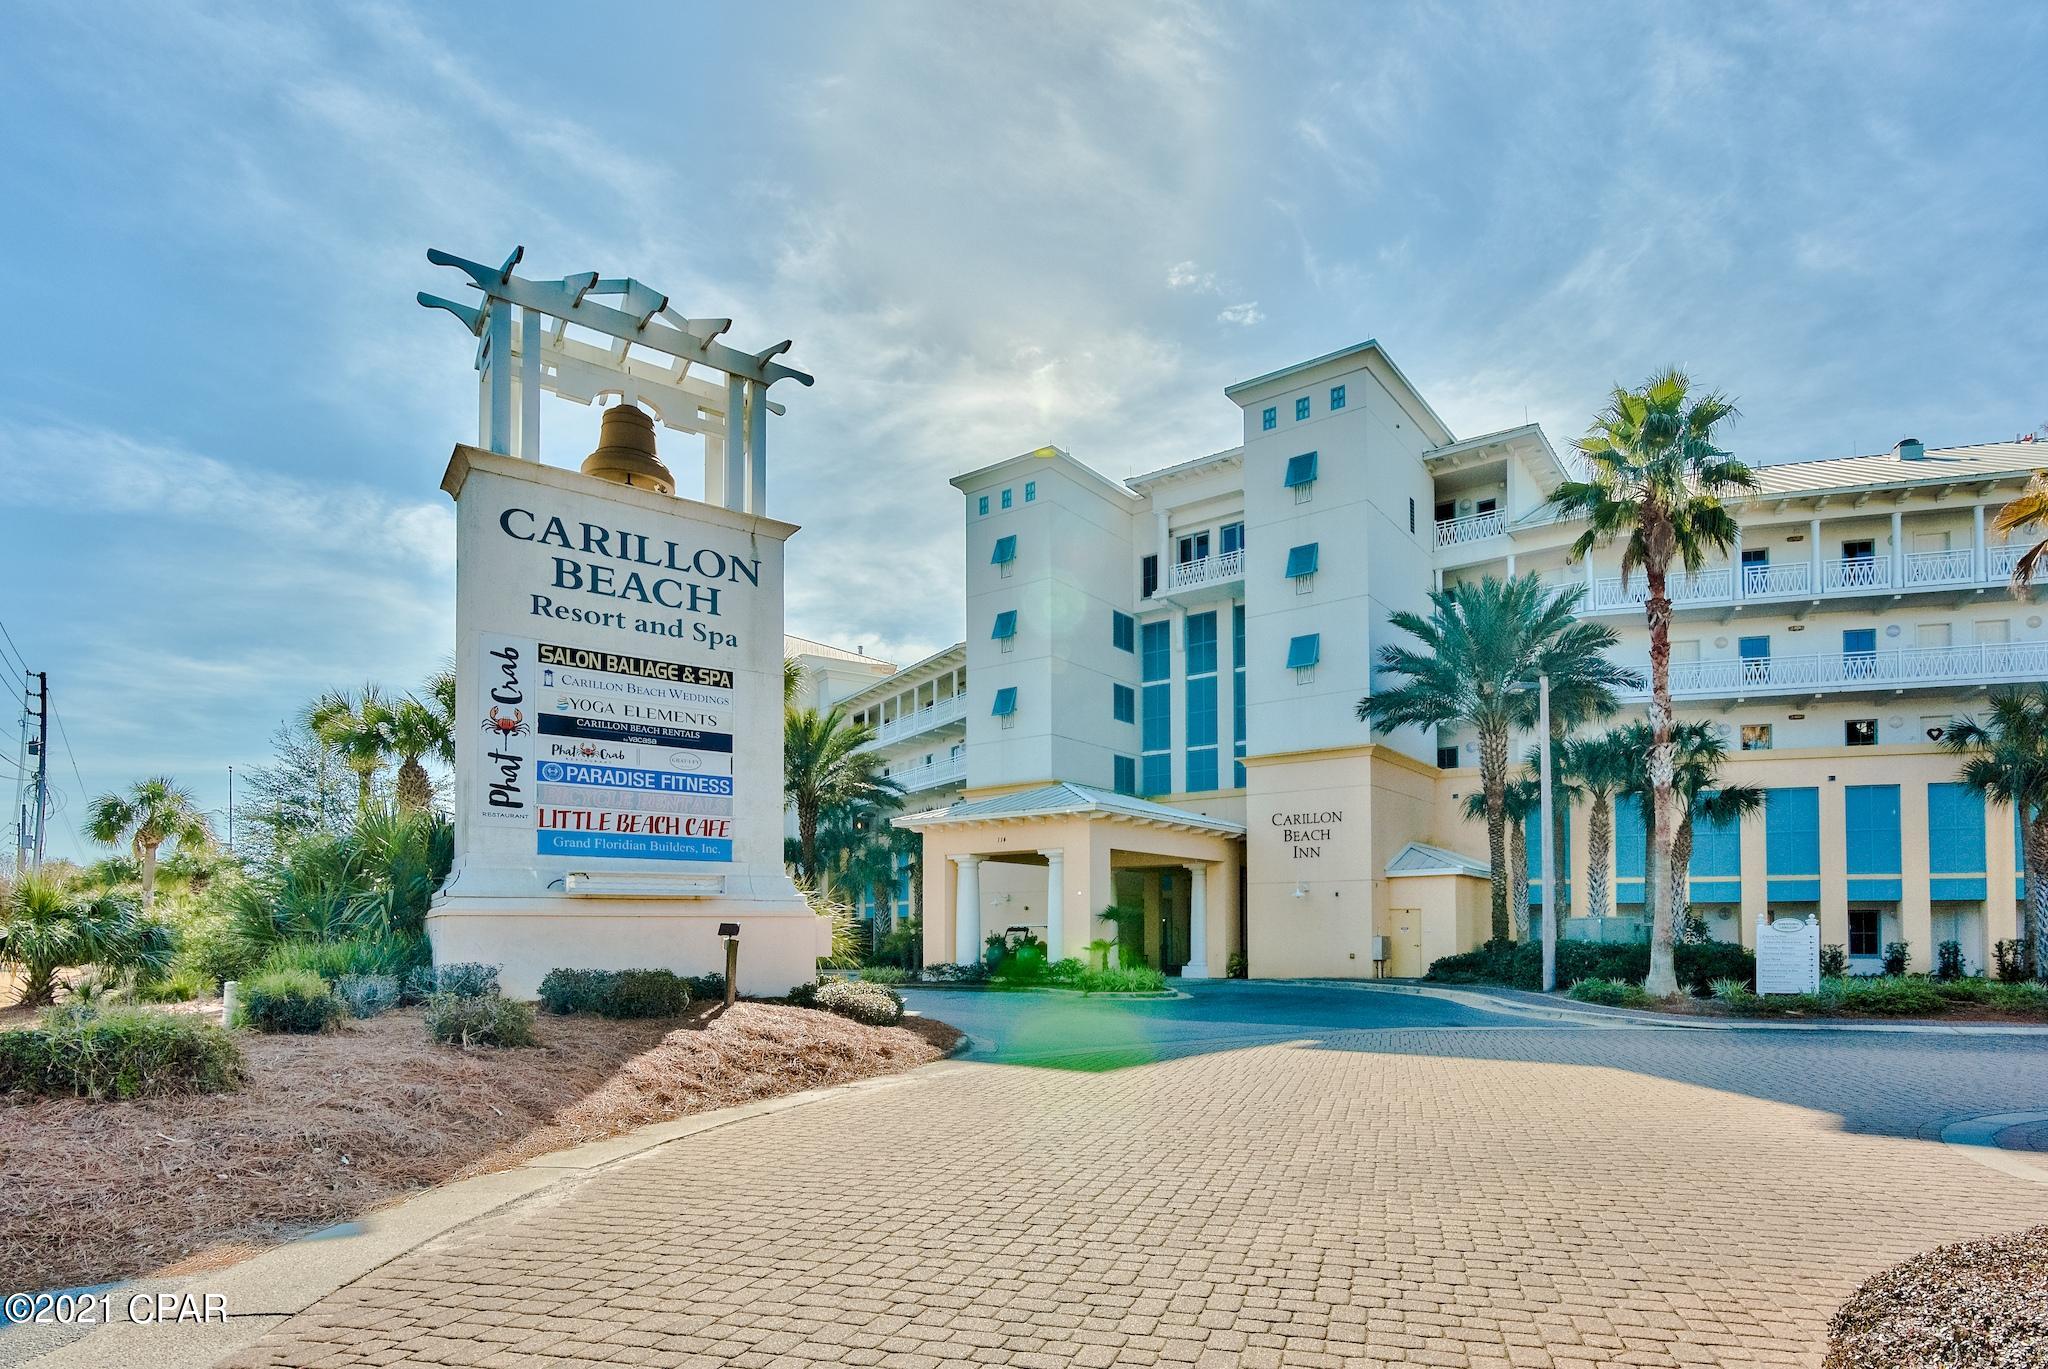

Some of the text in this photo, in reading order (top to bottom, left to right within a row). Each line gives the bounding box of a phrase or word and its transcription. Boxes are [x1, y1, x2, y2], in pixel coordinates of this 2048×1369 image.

[499, 508, 762, 587] CARILLON
[551, 556, 722, 616] BEACH
[530, 594, 738, 650] Resort and Spa
[540, 645, 731, 688] SALON BALIAGE & SPA
[561, 674, 730, 706] CARILLON BEACH WEDDINGS
[568, 697, 718, 727] YOGA ELEMENTS
[488, 646, 524, 808] Phat Crab
[576, 718, 701, 739] CARILLON BEACH RENTALS
[628, 736, 657, 745] vacasa
[552, 743, 625, 760] Phat Crab
[566, 765, 731, 794] PARADISE FITNESS
[482, 811, 529, 820] RESTAURANT
[538, 808, 731, 838] LITTLE BEACH CAFE
[1271, 811, 1342, 826] CARILLON
[553, 836, 721, 854] Grand Floridian Builders, Inc.
[1284, 829, 1331, 842] BEACH
[1293, 846, 1321, 858] INN
